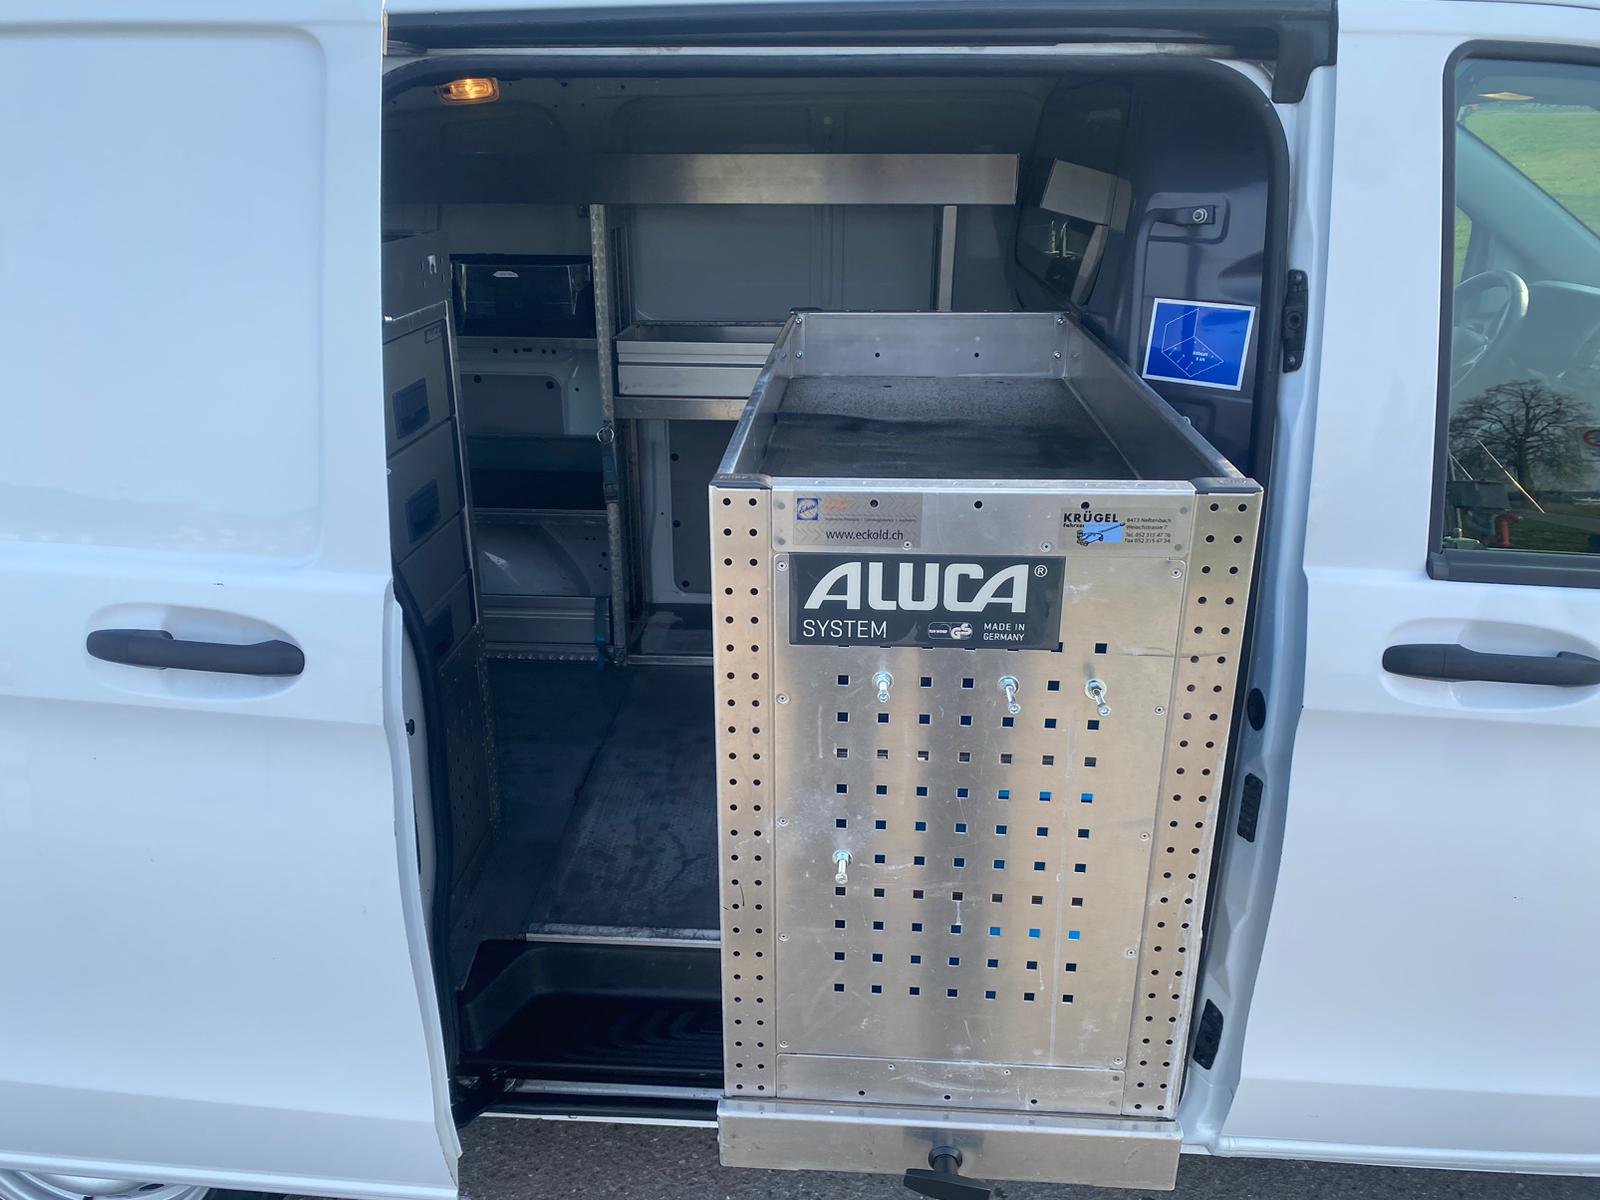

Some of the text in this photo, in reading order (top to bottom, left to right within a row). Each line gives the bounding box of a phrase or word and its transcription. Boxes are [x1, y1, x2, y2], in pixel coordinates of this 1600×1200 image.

[1064, 510, 1118, 522] KRÜGEL
[826, 529, 904, 540] www.eckold.ch
[802, 619, 887, 638] SYSTEM
[984, 623, 1012, 631] MADE
[983, 633, 1025, 641] GERMANY
